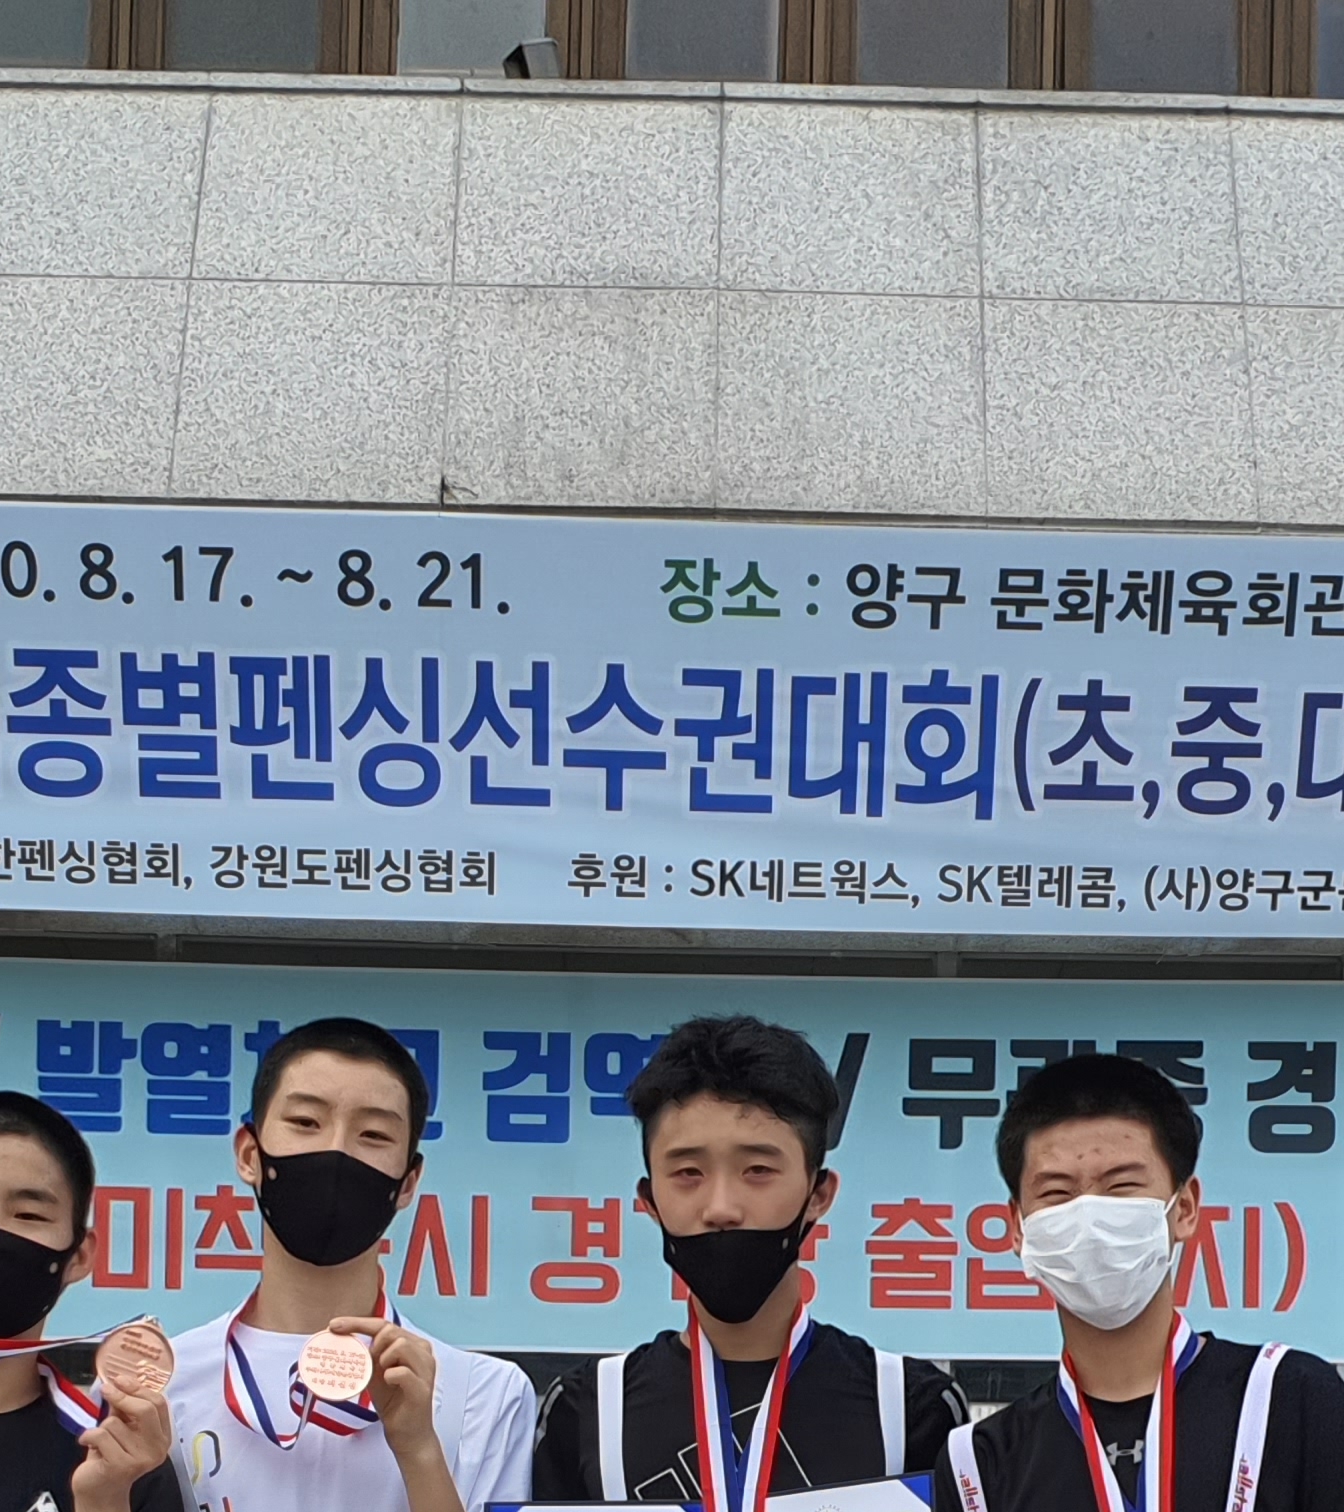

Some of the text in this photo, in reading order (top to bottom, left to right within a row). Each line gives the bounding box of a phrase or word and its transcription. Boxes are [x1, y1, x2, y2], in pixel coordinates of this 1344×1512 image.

[79, 542, 135, 604] 8.
[162, 545, 253, 607] 17.
[338, 549, 392, 611] 8.
[417, 551, 510, 614] 21.
[660, 558, 781, 624] 장소
[846, 564, 966, 629] 양구
[210, 844, 496, 896] 강원도펜싱협회
[568, 854, 647, 898] 후원
[690, 858, 920, 908] SK네트웍스,
[938, 864, 1126, 912] SK텔레콤,
